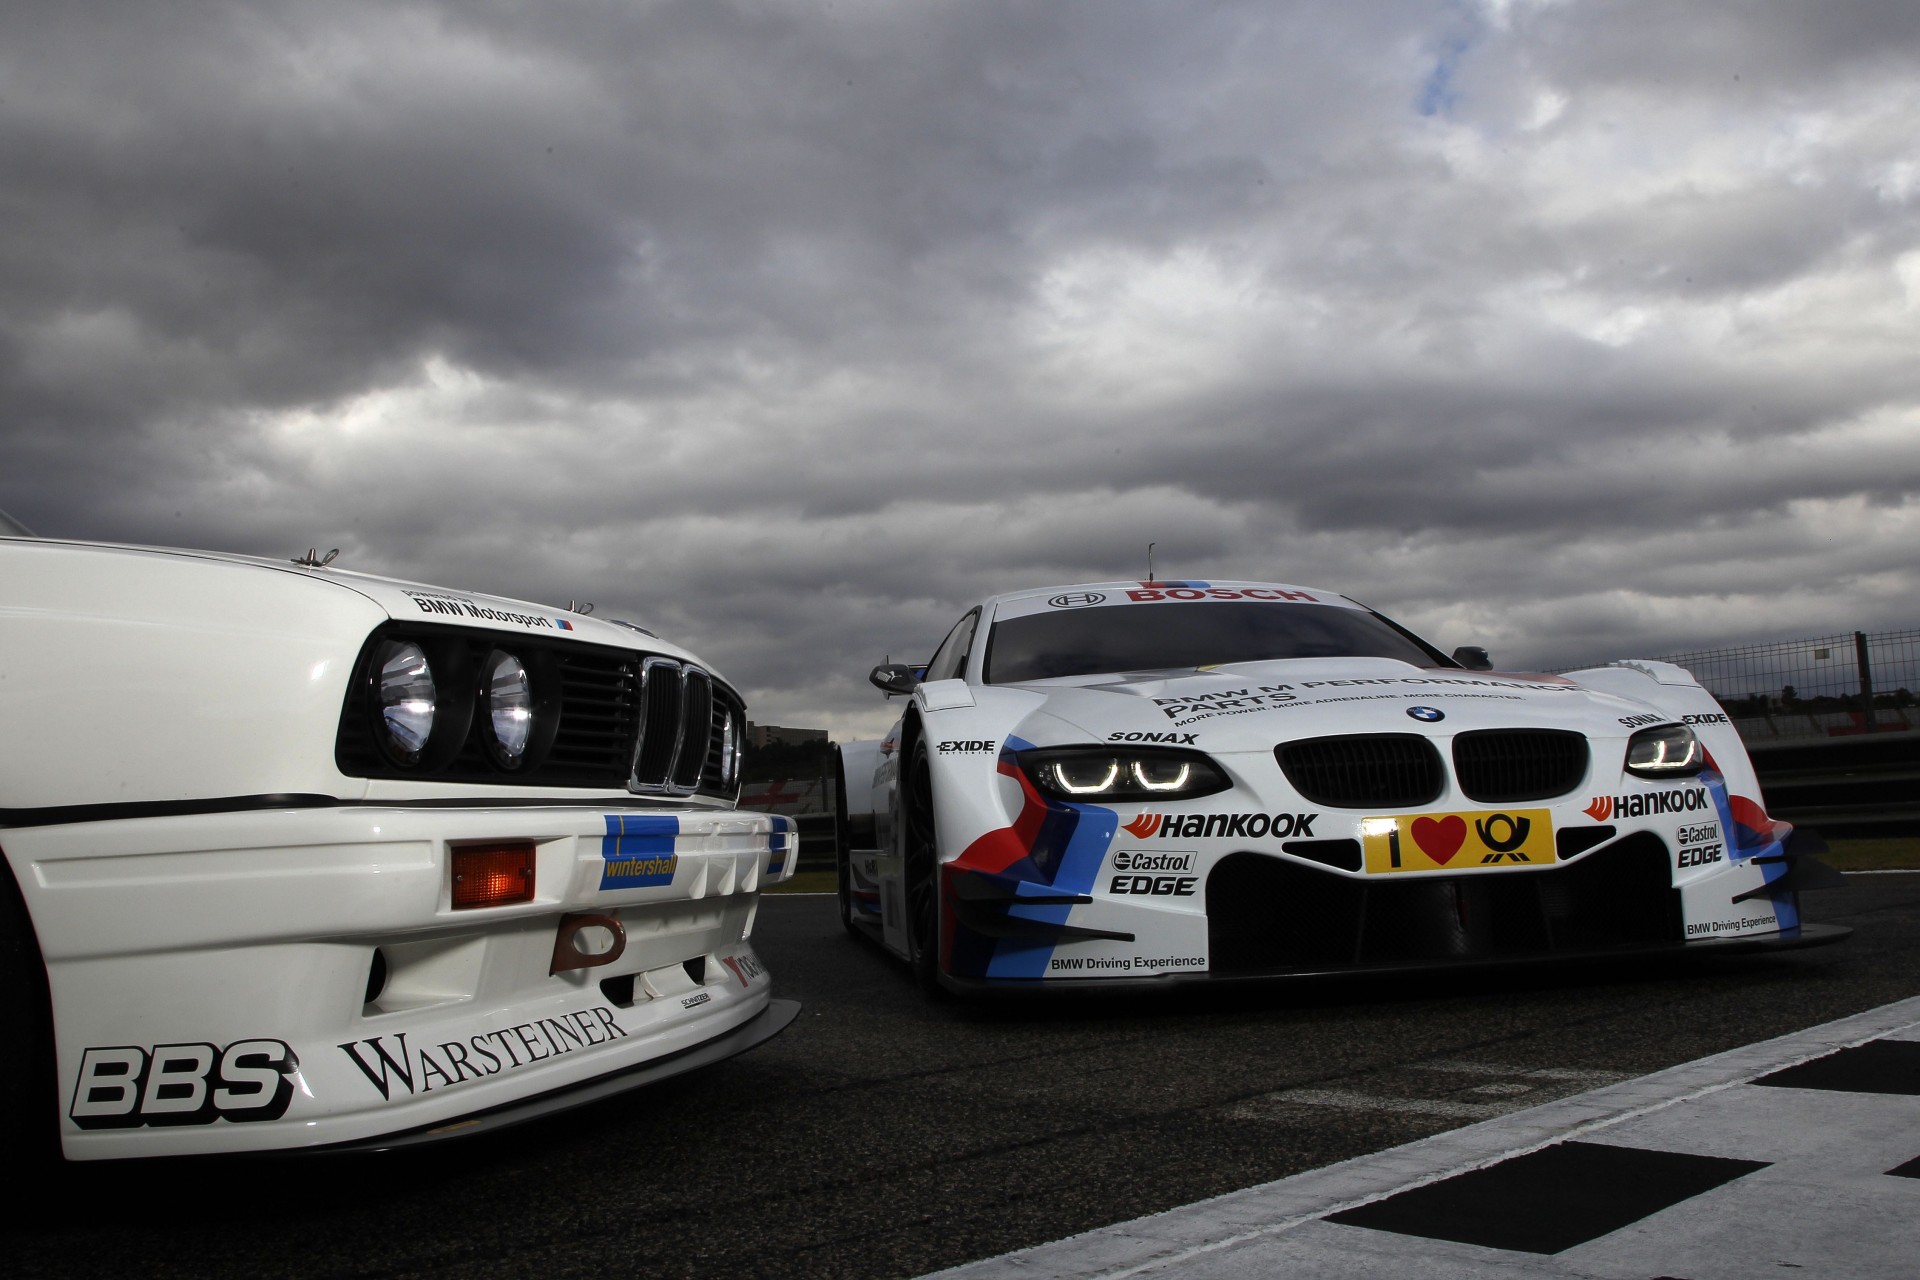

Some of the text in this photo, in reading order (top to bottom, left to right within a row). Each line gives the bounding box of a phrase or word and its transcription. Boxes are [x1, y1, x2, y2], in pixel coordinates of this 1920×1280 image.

[1125, 588, 1320, 602] BOSCH
[412, 598, 554, 628] BMW Motorsport
[1152, 678, 1590, 706] BMW M PERFORMANCE
[1163, 693, 1297, 719] PARTS
[1174, 713, 1215, 727] MORE
[1272, 701, 1313, 710] MORE
[1618, 713, 1666, 728] SONAX
[1681, 713, 1728, 725] EXIDE
[936, 740, 995, 751] EXIDE
[1107, 732, 1200, 745] SONAX
[1388, 819, 1402, 868] I
[1689, 825, 1718, 844] Castrol
[606, 855, 678, 877] wintershall
[1131, 853, 1190, 870] Castrol
[1678, 843, 1722, 869] EDGE
[1109, 875, 1199, 896] EDGE
[1687, 915, 1776, 935] BMW Driving Experience
[1051, 956, 1206, 971] BMW Driving Experience
[337, 1006, 628, 1101] WARSTEINER
[69, 1038, 300, 1129] BBS
